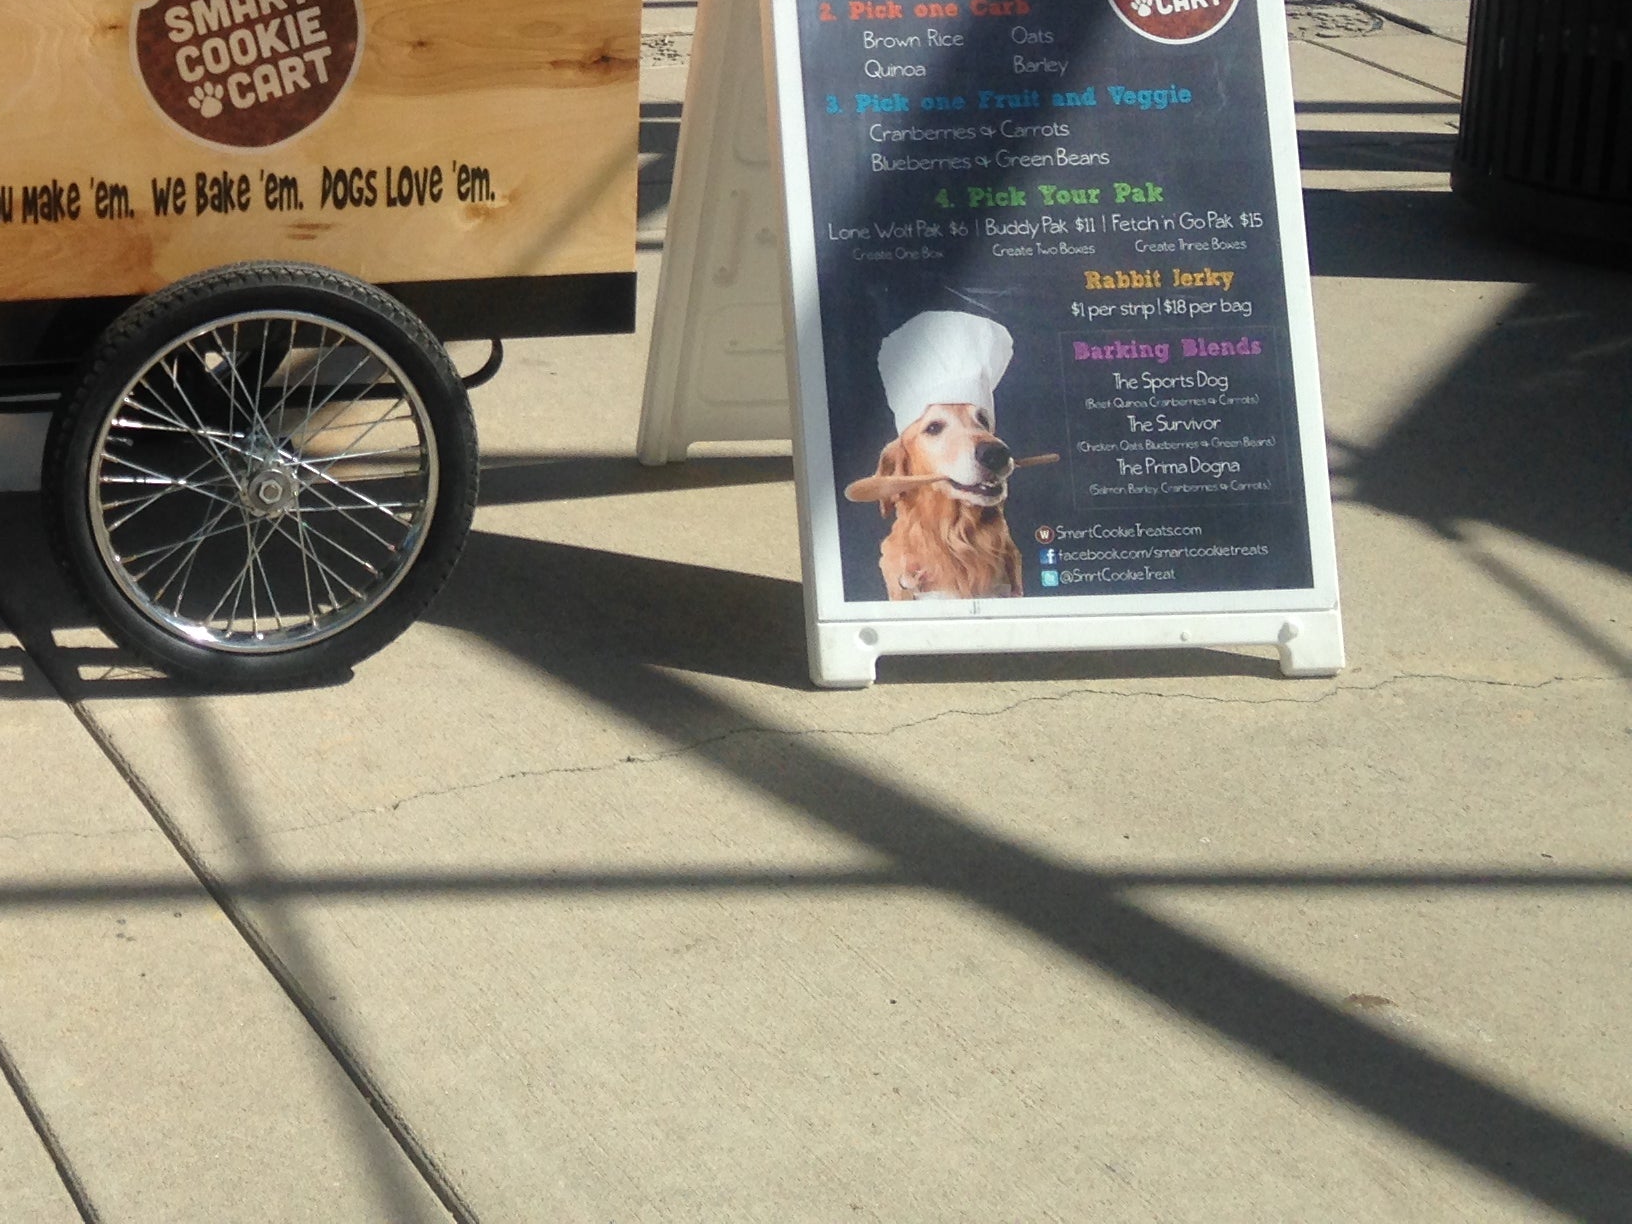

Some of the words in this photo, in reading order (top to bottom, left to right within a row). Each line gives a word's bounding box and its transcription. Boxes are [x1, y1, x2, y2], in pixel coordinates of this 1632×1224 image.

[820, 3, 837, 21] 2.
[849, 0, 903, 20] Pick
[914, 2, 959, 18] one
[175, 6, 328, 82] COOKIE
[864, 30, 920, 50] Brown
[928, 29, 964, 47] Rice
[1011, 26, 1054, 44] Oats
[864, 59, 926, 79] Quinoa
[1014, 55, 1068, 76] Barley
[227, 46, 332, 109] CART
[826, 96, 842, 114] 3.
[856, 93, 909, 114] Pick
[921, 94, 966, 110] one
[978, 89, 1040, 109] Fruit
[1052, 87, 1096, 107] and
[1108, 84, 1192, 111] Veggie
[869, 123, 976, 143] Cranberries
[1000, 120, 1070, 138] Carrots
[871, 153, 972, 172] Blueberries
[995, 150, 1053, 168] Green
[1056, 147, 1110, 167] Beans
[934, 188, 954, 208] 4.
[968, 185, 1026, 207] Pick
[1038, 183, 1100, 206] Your
[1113, 181, 1164, 204] Pak
[828, 222, 870, 240] Lone
[874, 221, 913, 239] Wolf
[917, 220, 944, 238] Pak
[950, 220, 968, 238] $6
[985, 217, 1039, 239] Buddy
[1042, 216, 1068, 234] Pak
[1075, 216, 1095, 233] $11
[1111, 214, 1159, 232] Fetch
[1179, 212, 1206, 229] Go
[1208, 211, 1234, 228] Pak
[1240, 211, 1264, 228] $15
[853, 247, 893, 261] Create
[895, 246, 918, 259] One
[922, 246, 944, 259] Box
[992, 243, 1033, 257] Create
[1035, 242, 1058, 256] Two
[1059, 241, 1095, 255] Boxes
[1135, 239, 1175, 253] Create
[1178, 238, 1210, 251] Three
[1210, 237, 1247, 251] Boxes
[1084, 269, 1161, 290] Rabbit
[1172, 267, 1234, 291] Jerky
[1071, 302, 1086, 317] $1
[1088, 304, 1116, 321] per
[1120, 302, 1155, 319] strip
[1164, 299, 1187, 314] $18
[1189, 302, 1217, 318] per
[1221, 297, 1252, 317] bag
[1072, 339, 1170, 363] Barking
[1181, 336, 1262, 357] Blends
[1112, 372, 1138, 390] The
[1142, 371, 1194, 394] Sports
[1197, 370, 1229, 391] Dog
[1127, 415, 1153, 432] The
[1156, 414, 1221, 432] Survivor
[1116, 458, 1143, 475] The
[1145, 457, 1187, 474] Prima
[1189, 456, 1240, 478] Dogna
[1055, 523, 1202, 540] SmartCookieTreats.com
[1058, 544, 1268, 561] facebook.com/smartcookietreats
